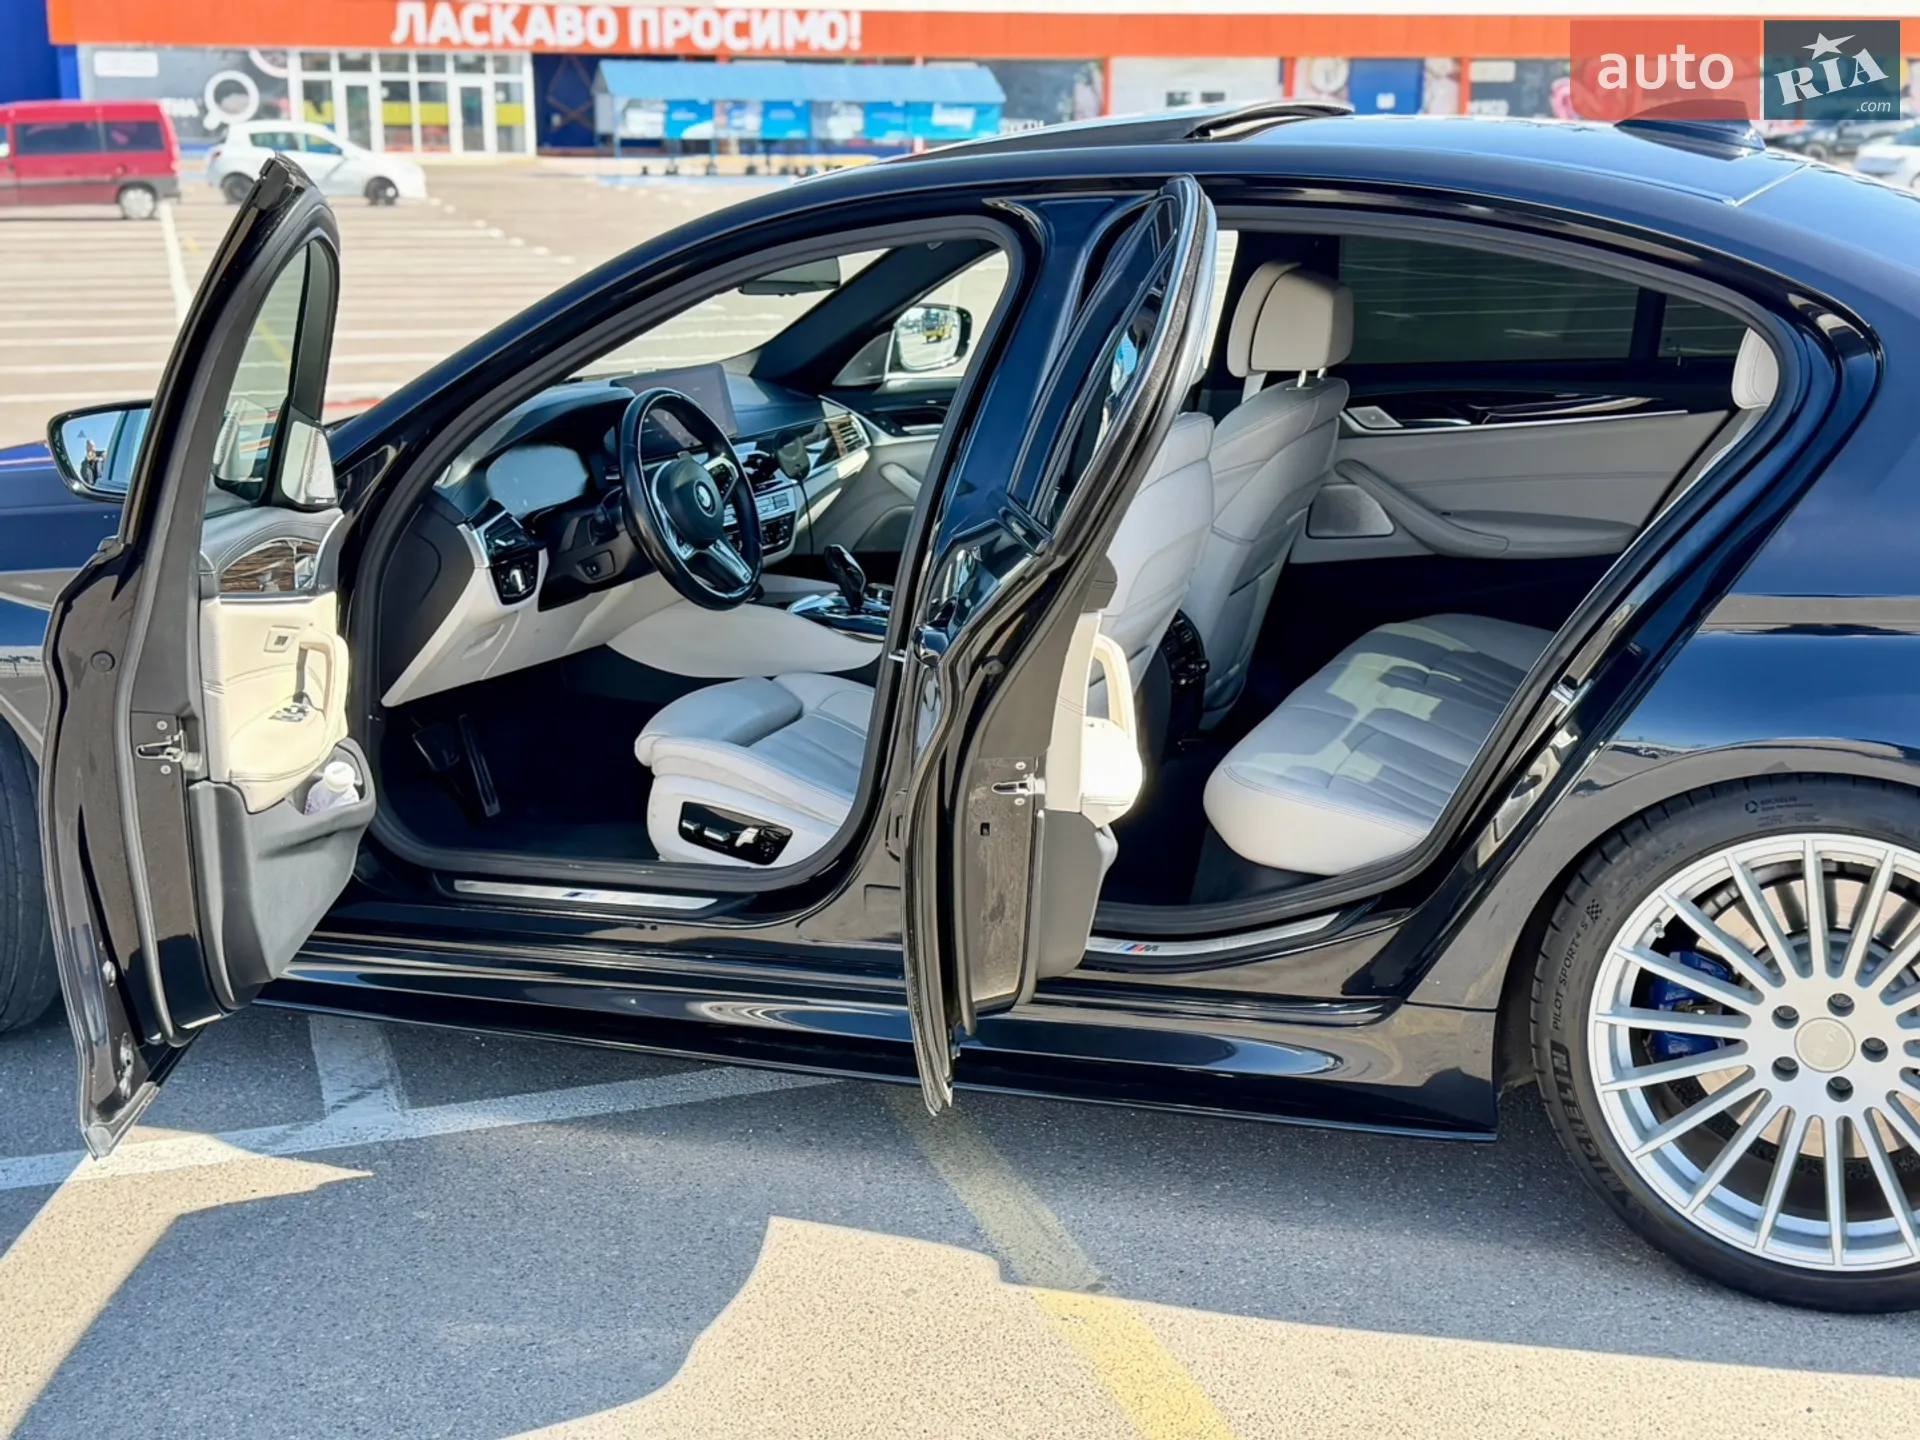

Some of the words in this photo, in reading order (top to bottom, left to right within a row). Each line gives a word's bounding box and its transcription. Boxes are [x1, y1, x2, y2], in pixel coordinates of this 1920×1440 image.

[391, 1, 618, 47] ЛАСКАВО
[627, 8, 862, 51] ПРОСИМО!
[1552, 992, 1564, 1031] PILOT
[1559, 937, 1581, 987] SPORT
[1552, 1050, 1625, 1192] MICHELIN
